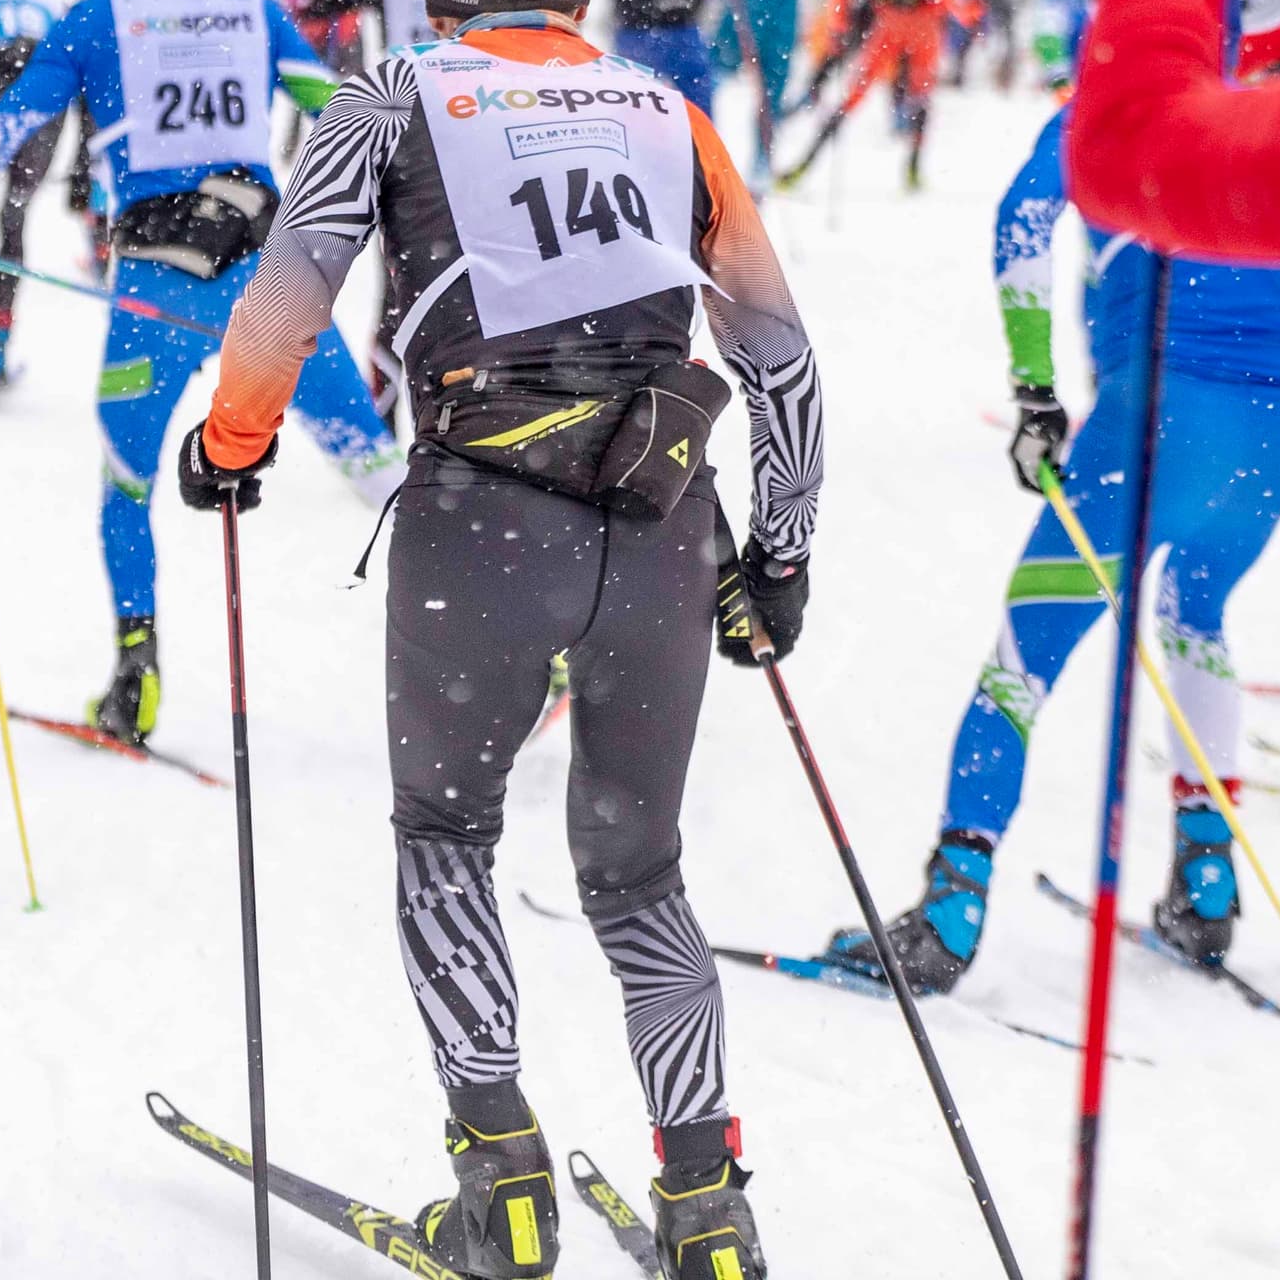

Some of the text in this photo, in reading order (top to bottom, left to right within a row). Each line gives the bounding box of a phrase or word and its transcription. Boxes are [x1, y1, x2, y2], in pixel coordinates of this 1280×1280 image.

[155, 77, 246, 132] 246
[446, 85, 669, 120] ekosport
[509, 168, 663, 262] 149
